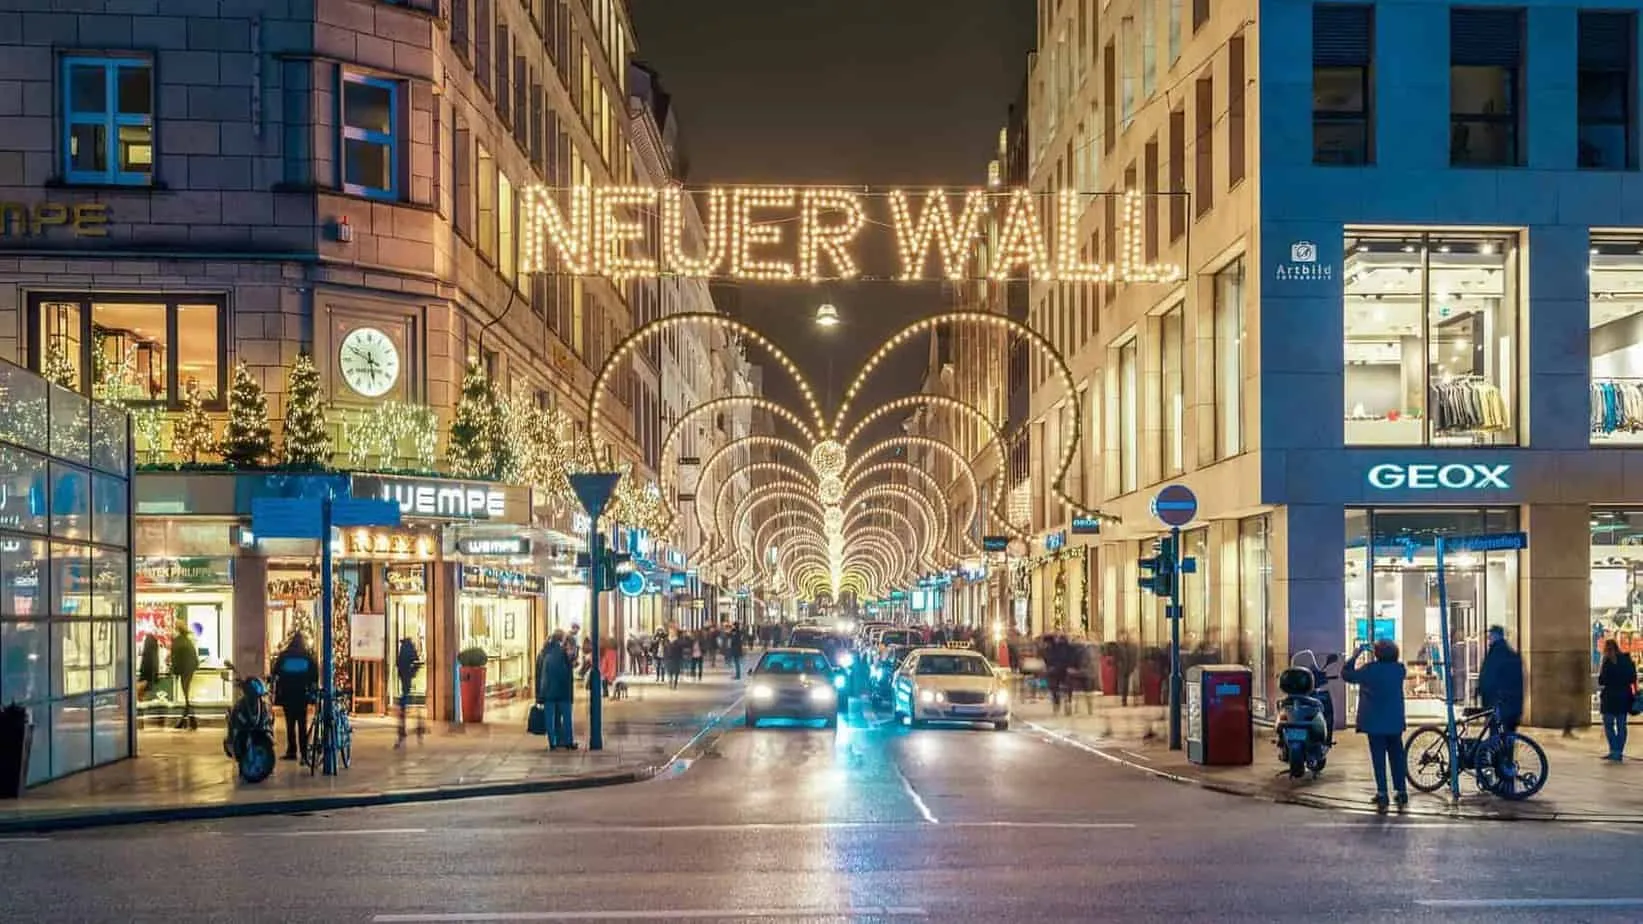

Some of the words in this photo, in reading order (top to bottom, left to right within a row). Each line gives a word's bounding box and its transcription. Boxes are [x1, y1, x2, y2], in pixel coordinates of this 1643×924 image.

[521, 184, 866, 283] NEUER
[887, 188, 1181, 283] WALL
[1276, 263, 1332, 274] Artbild
[1367, 464, 1511, 489] GEOX
[383, 484, 505, 516] WEMPE
